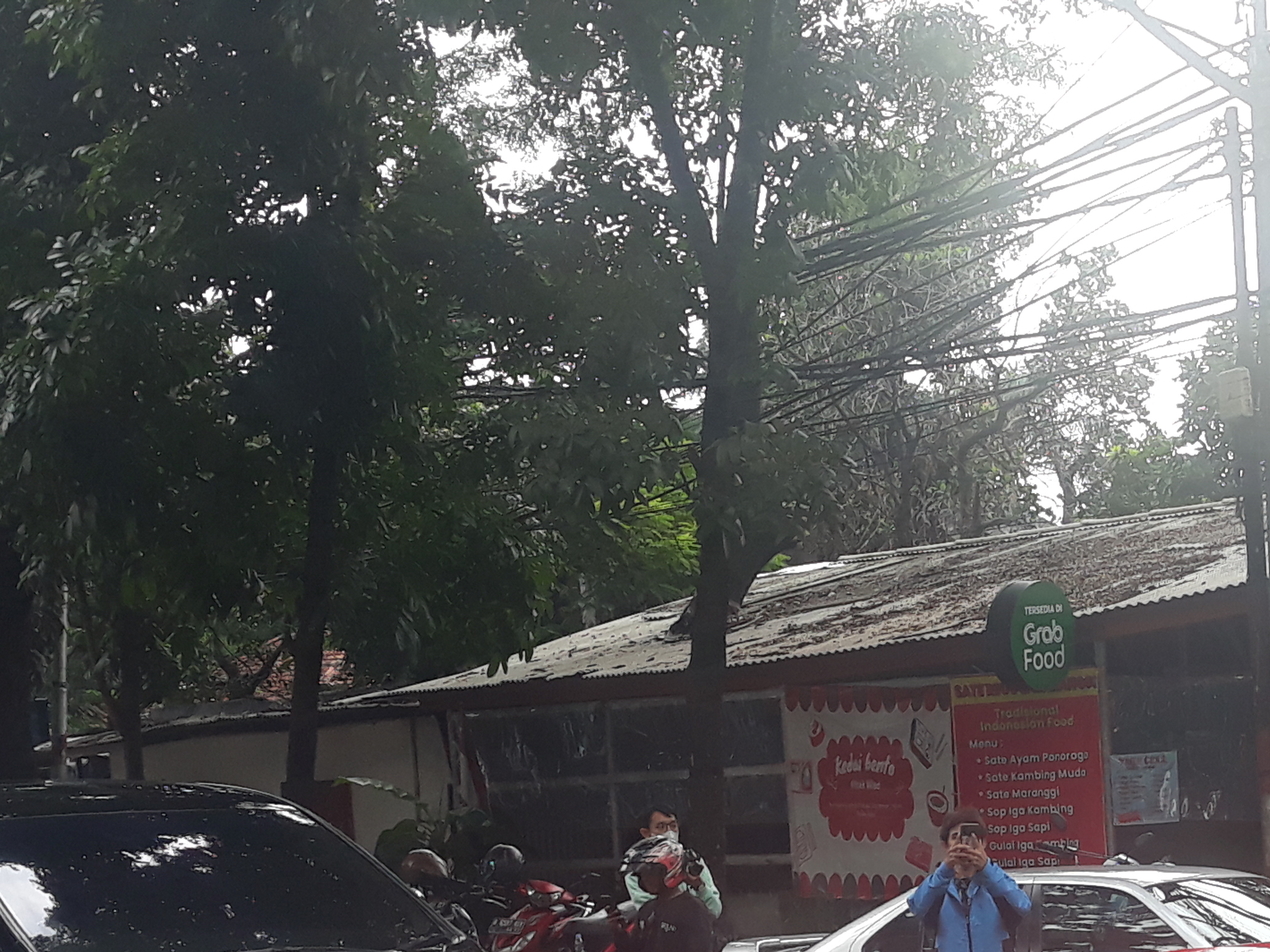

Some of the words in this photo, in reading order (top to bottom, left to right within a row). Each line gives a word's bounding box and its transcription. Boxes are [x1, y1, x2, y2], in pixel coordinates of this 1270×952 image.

[1024, 605, 1054, 616] TERSEDIA
[1055, 604, 1063, 613] DI
[1023, 619, 1064, 646] Grab
[1023, 643, 1065, 671] Food
[1047, 714, 1075, 728] Food
[969, 739, 998, 749] Menu
[985, 755, 1008, 766] Sate
[1010, 754, 1040, 766] Ayam
[985, 772, 1008, 782] Sate
[1011, 769, 1056, 782] Kambing
[1058, 767, 1086, 778] Muda
[986, 789, 1010, 800] Sate
[1012, 785, 1060, 800] Maranggi
[987, 807, 1007, 819] Sop
[1009, 806, 1025, 818] Iga
[1027, 803, 1074, 816] Kambing
[988, 824, 1007, 836] Sop
[1010, 822, 1026, 835] Iga
[1028, 821, 1051, 834] Sapi
[989, 840, 1015, 851] Gulai
[1018, 840, 1034, 853] Iga
